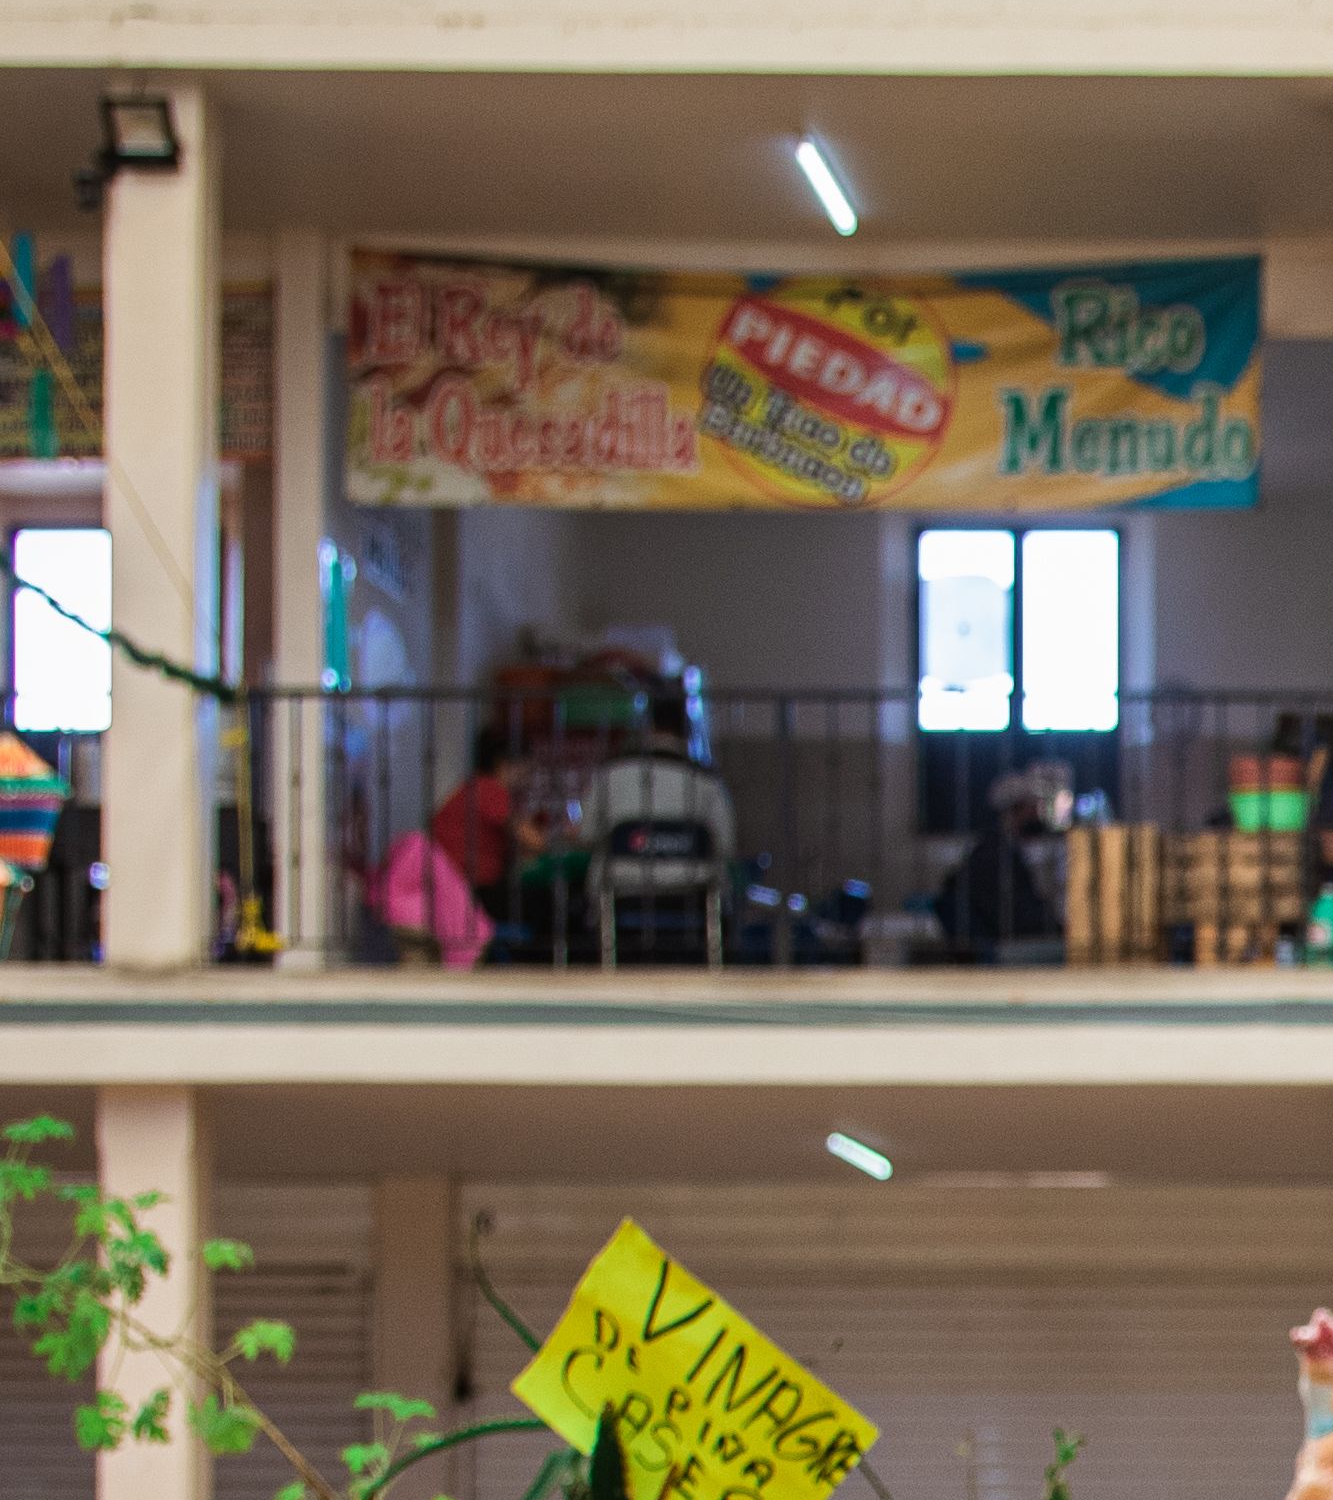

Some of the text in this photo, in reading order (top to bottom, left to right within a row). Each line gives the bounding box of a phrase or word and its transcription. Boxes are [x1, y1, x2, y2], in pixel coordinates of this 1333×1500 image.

[440, 286, 546, 390] Rey
[564, 282, 624, 363] de
[729, 305, 941, 432] PIEDAD
[1058, 283, 1200, 370] Rico
[370, 376, 698, 472] la Quesadilla
[1001, 385, 1254, 478] Menudo
